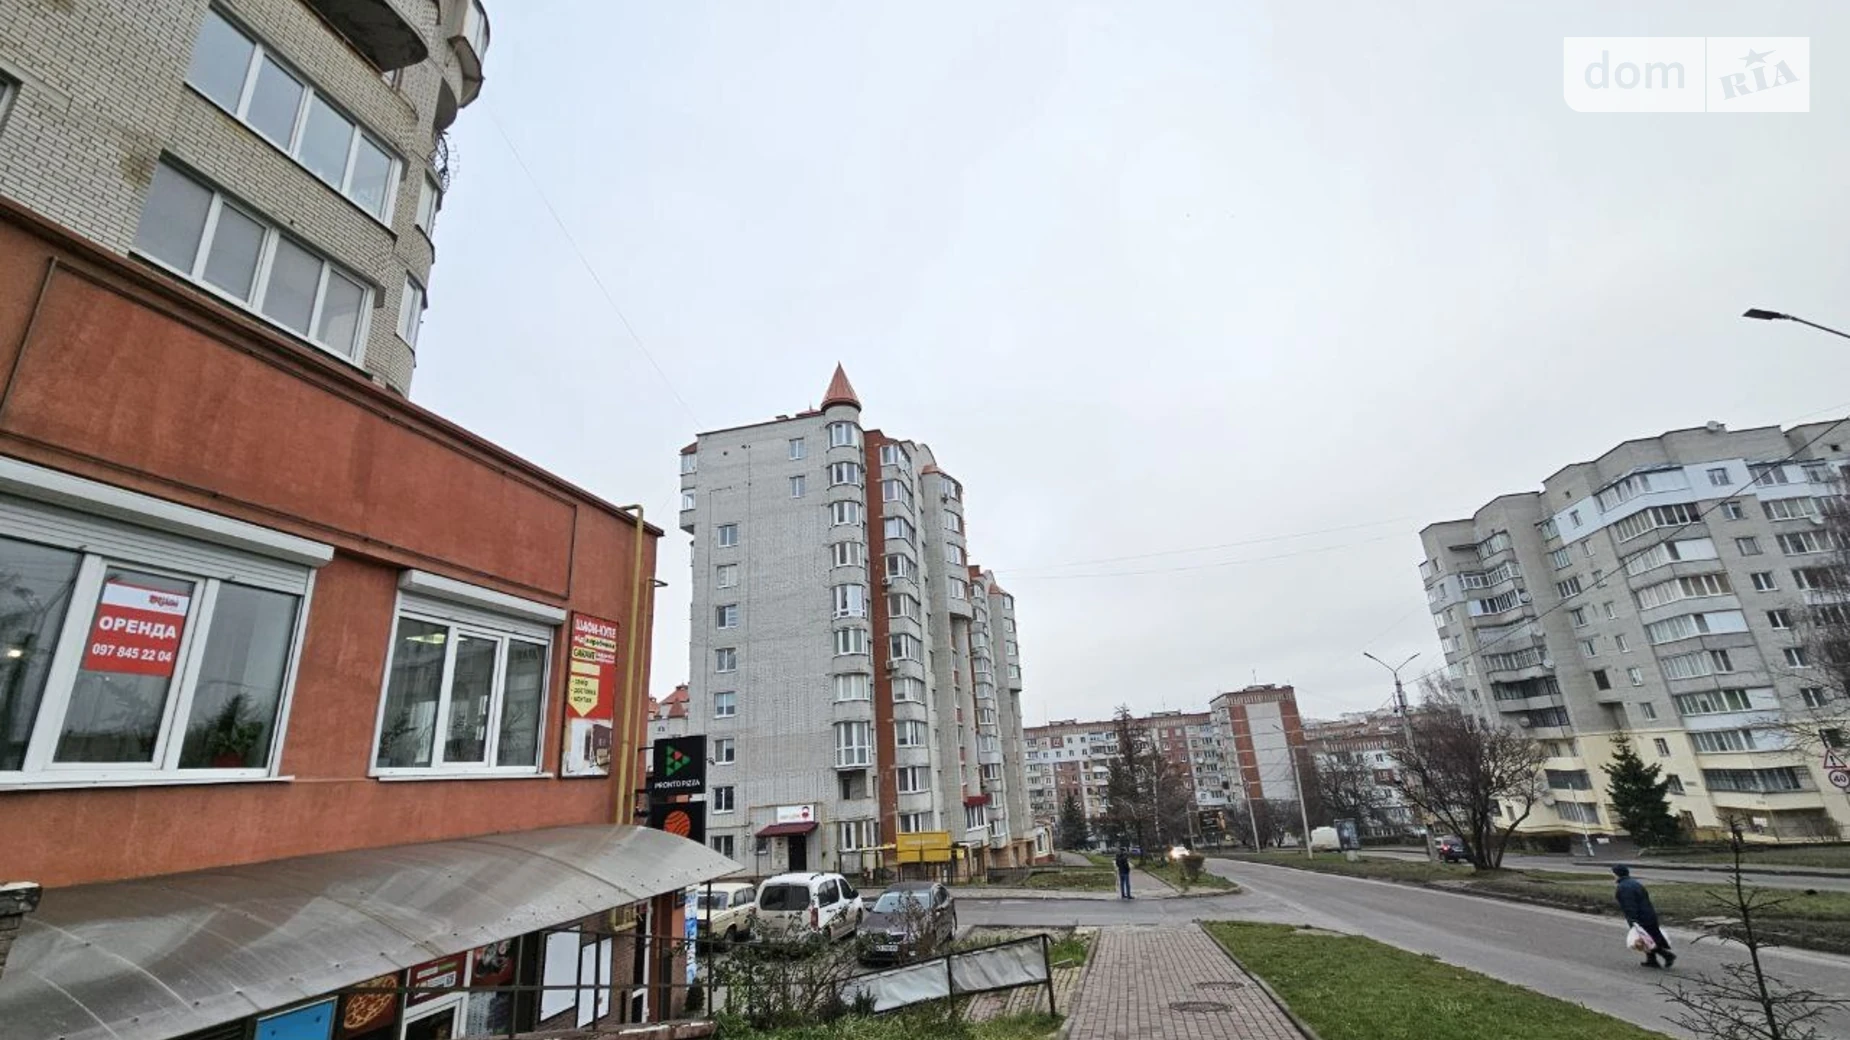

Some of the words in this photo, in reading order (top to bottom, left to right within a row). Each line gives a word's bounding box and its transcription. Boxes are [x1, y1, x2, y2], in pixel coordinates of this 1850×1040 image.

[99, 616, 176, 640] ОРЕНДА
[92, 643, 115, 656] 097
[117, 646, 139, 659] 845
[141, 649, 155, 661] 22
[158, 651, 172, 662] 04
[681, 779, 700, 787] PIZZA
